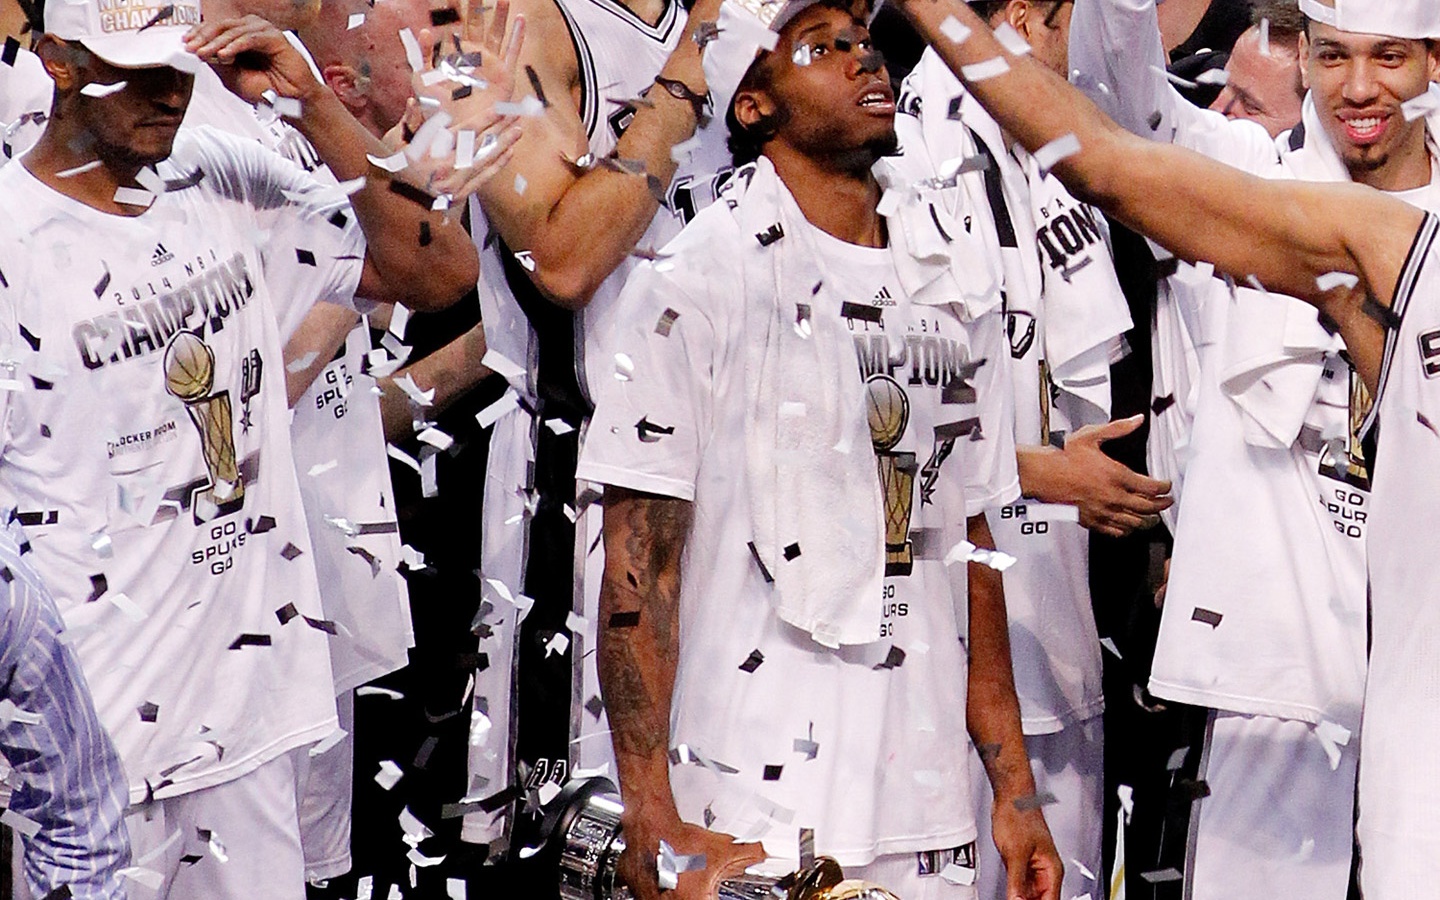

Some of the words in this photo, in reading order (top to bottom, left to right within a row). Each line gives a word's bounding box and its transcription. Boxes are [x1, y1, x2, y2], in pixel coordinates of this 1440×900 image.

[114, 277, 173, 306] 2014
[872, 299, 897, 307] adidas
[211, 521, 236, 540] GO
[1021, 521, 1049, 535] GO
[211, 556, 233, 575] GO
